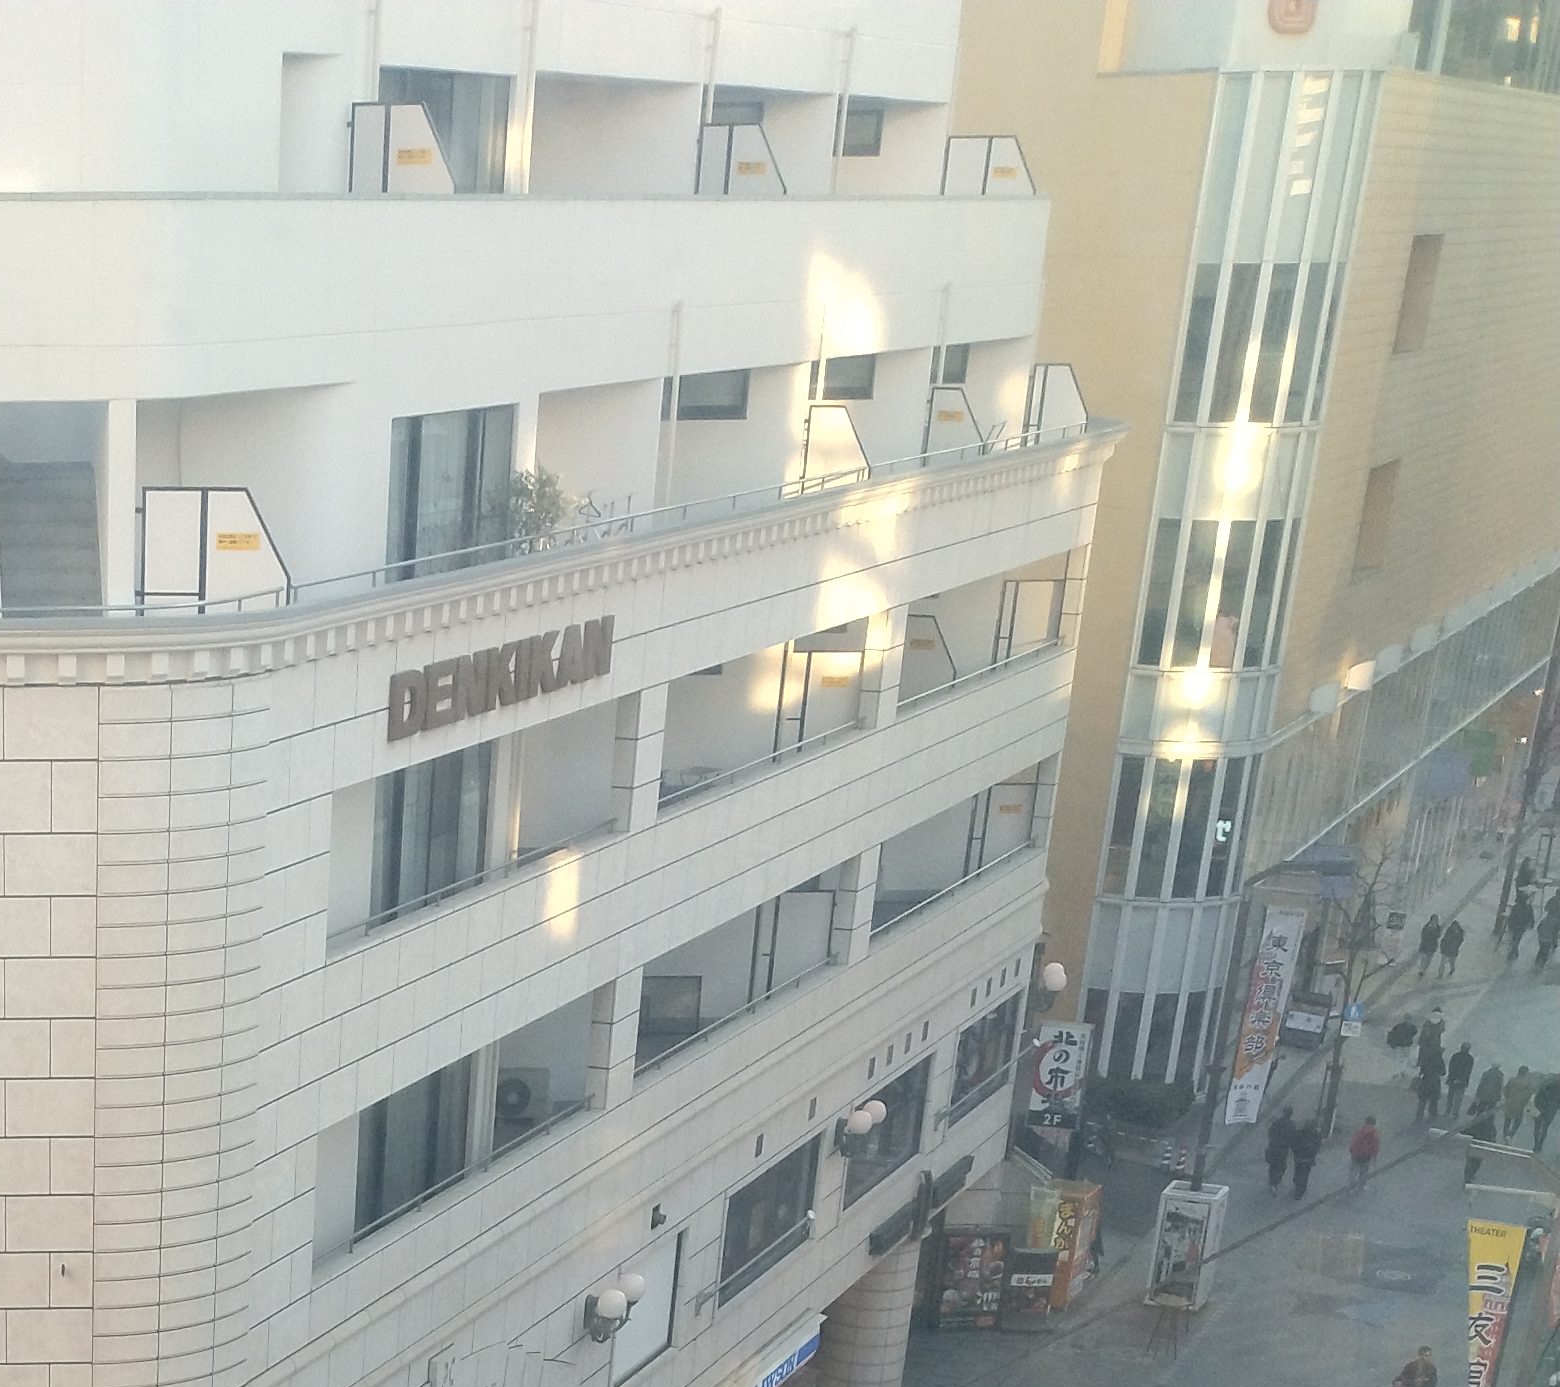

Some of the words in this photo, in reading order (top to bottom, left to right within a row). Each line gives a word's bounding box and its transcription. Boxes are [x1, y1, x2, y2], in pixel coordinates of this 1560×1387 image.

[387, 614, 616, 742] DENKIKAN
[1243, 932, 1290, 1055] 東京倶楽部
[1043, 1113, 1063, 1126] 2F
[1469, 1224, 1507, 1238] THEATER
